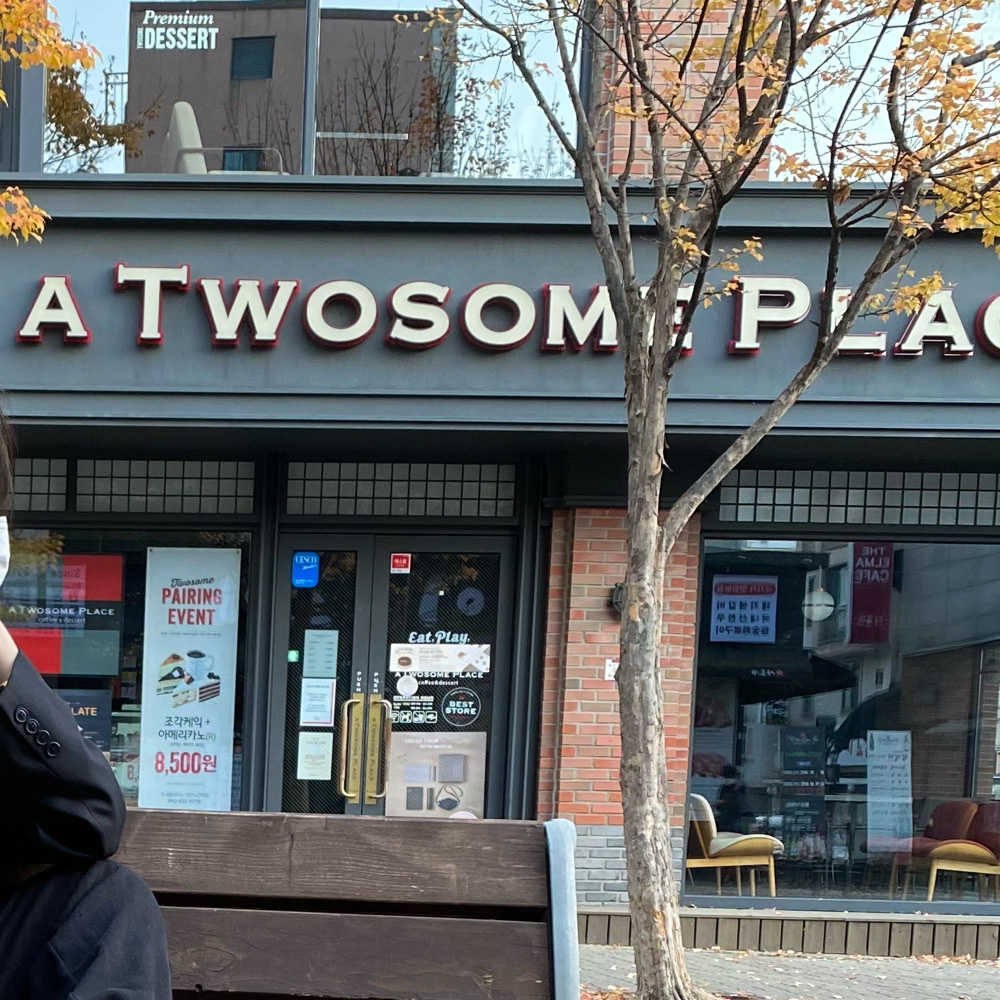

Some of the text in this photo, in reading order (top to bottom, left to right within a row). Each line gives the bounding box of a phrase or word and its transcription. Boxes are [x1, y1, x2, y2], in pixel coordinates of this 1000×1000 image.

[142, 9, 214, 25] Premium
[144, 27, 219, 50] DESSERT
[16, 275, 91, 343] A
[170, 577, 215, 588] Twosome
[161, 587, 223, 605] PAIRING
[18, 605, 75, 615] TWOSOME
[78, 607, 115, 616] PLACE
[167, 608, 215, 626] EVENT
[164, 716, 203, 728] 조각케익
[154, 751, 217, 776] 8,500원
